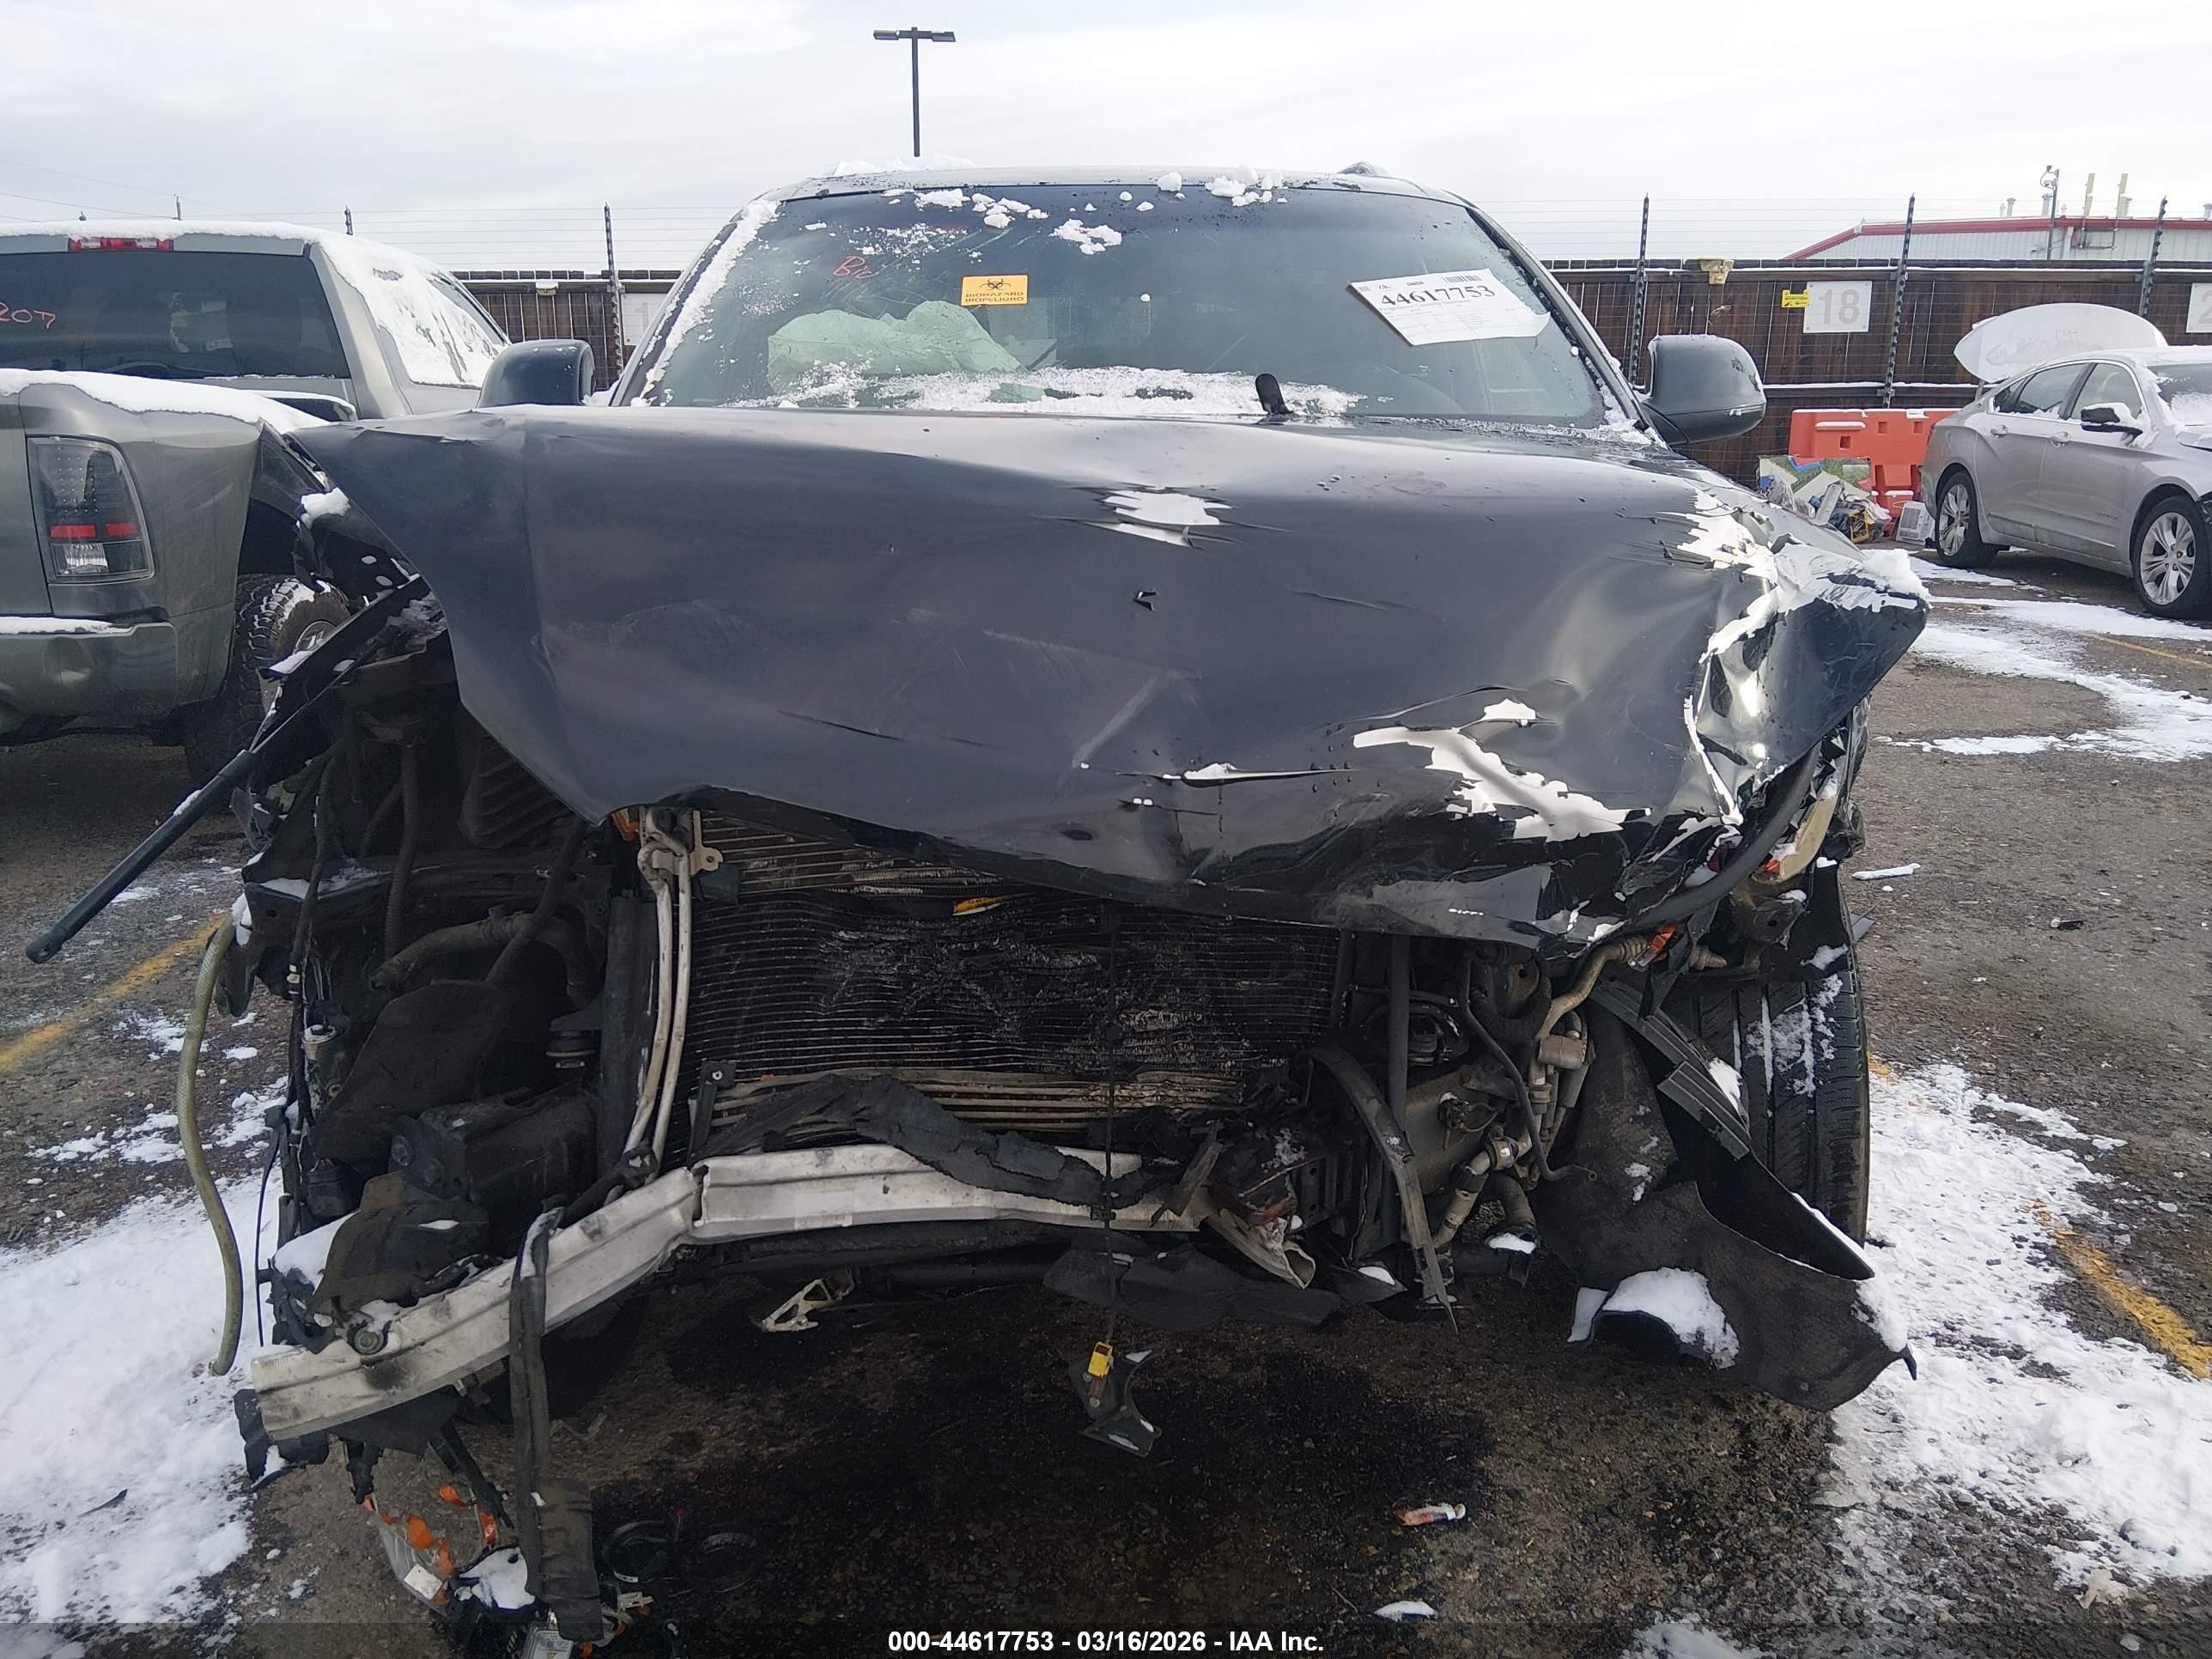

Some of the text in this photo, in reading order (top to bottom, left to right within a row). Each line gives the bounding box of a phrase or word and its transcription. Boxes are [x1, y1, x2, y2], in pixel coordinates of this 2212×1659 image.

[1381, 285, 1496, 306] 44617753
[1818, 289, 1861, 325] 18
[2198, 289, 2212, 324] 2
